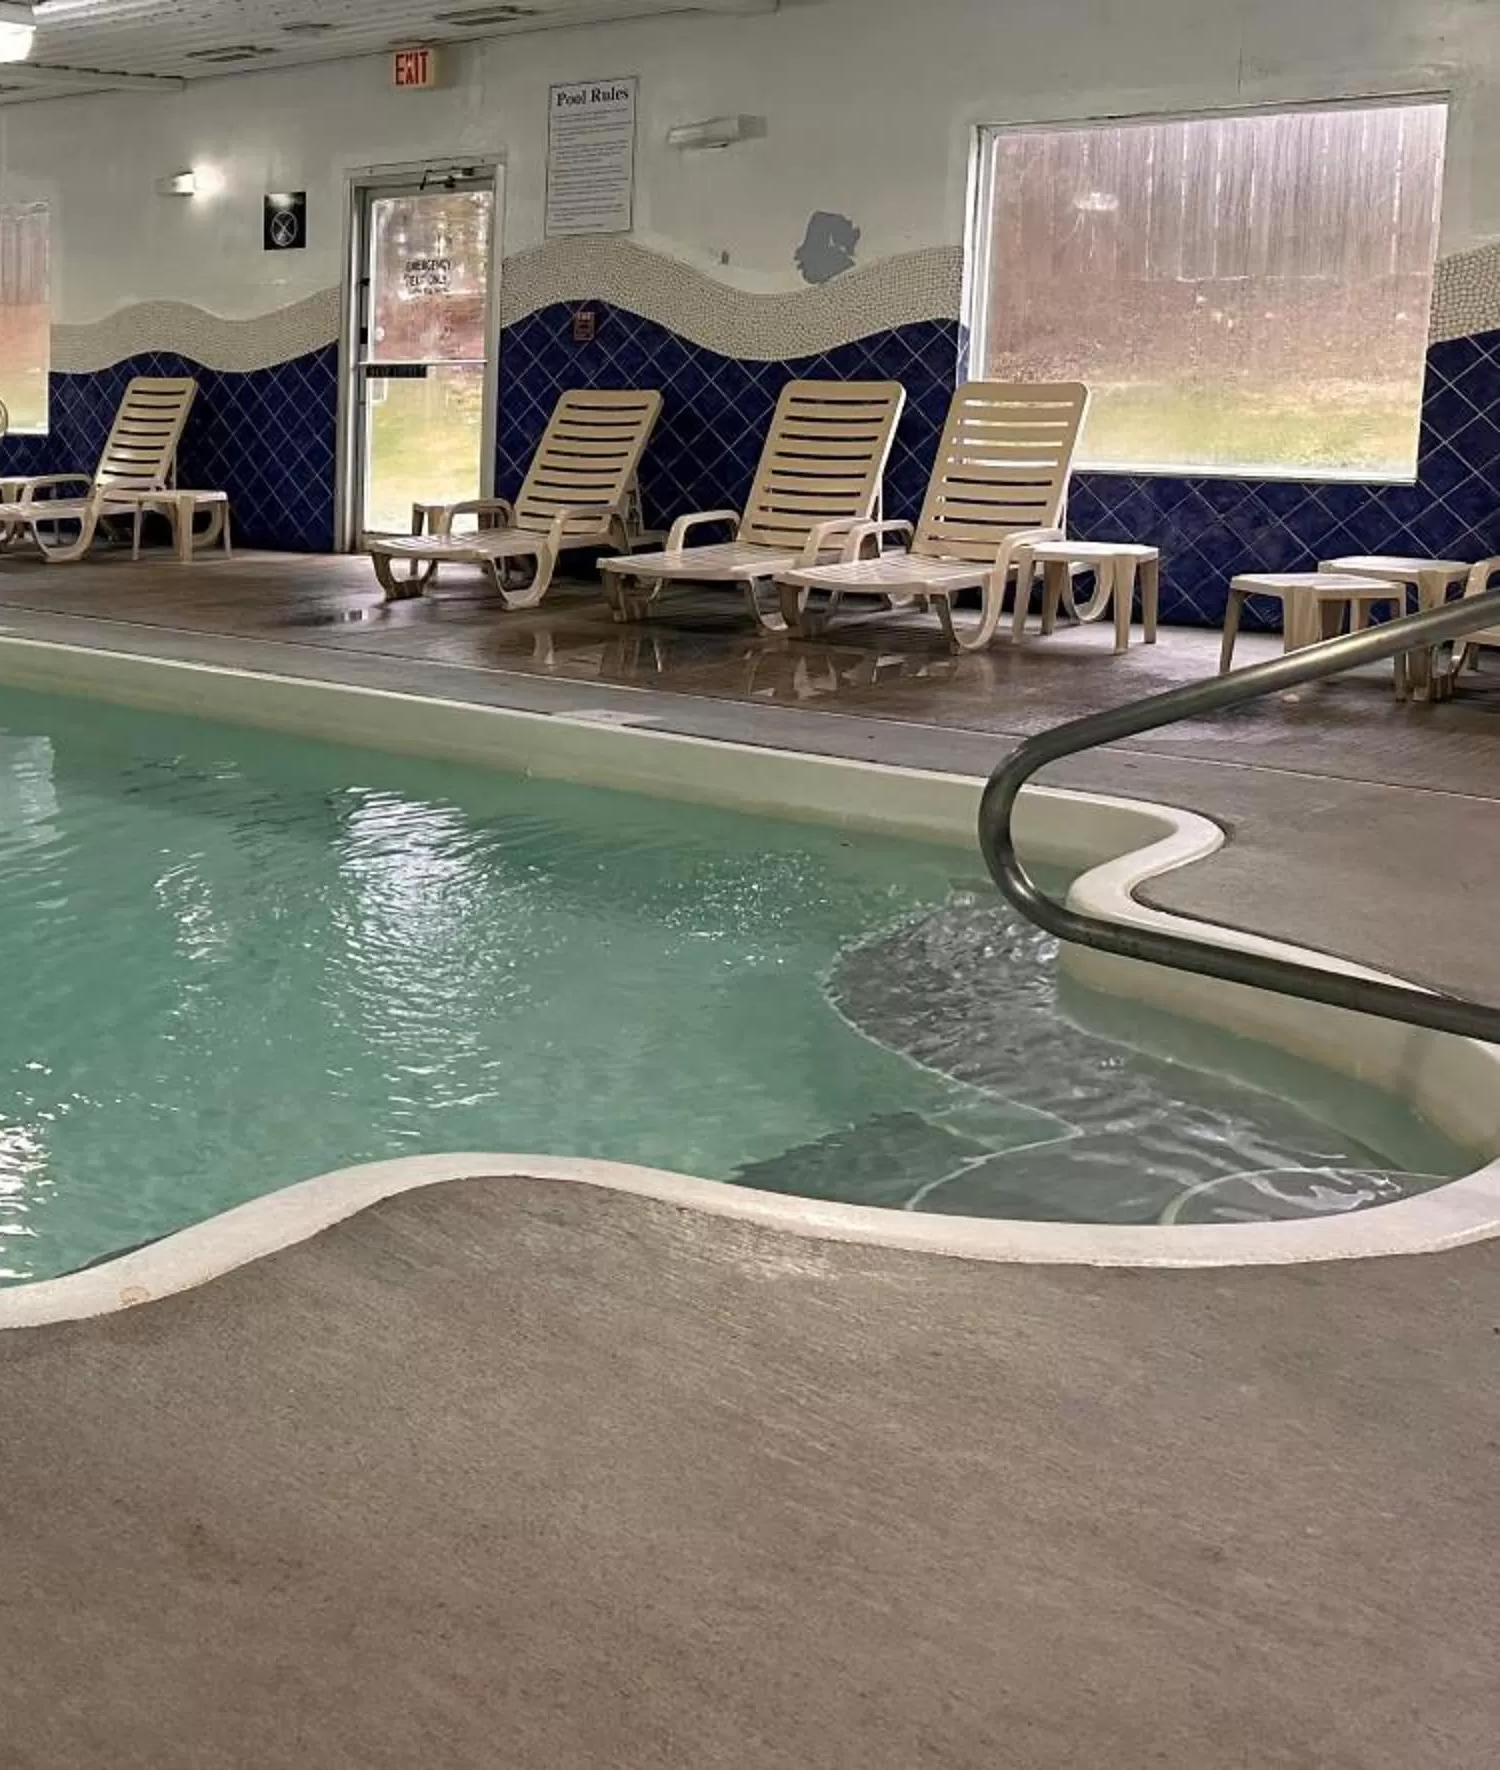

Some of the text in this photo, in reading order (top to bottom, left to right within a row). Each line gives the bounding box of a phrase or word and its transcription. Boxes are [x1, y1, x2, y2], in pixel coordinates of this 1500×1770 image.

[395, 51, 429, 85] EXIT
[556, 86, 629, 106] Pool Rules
